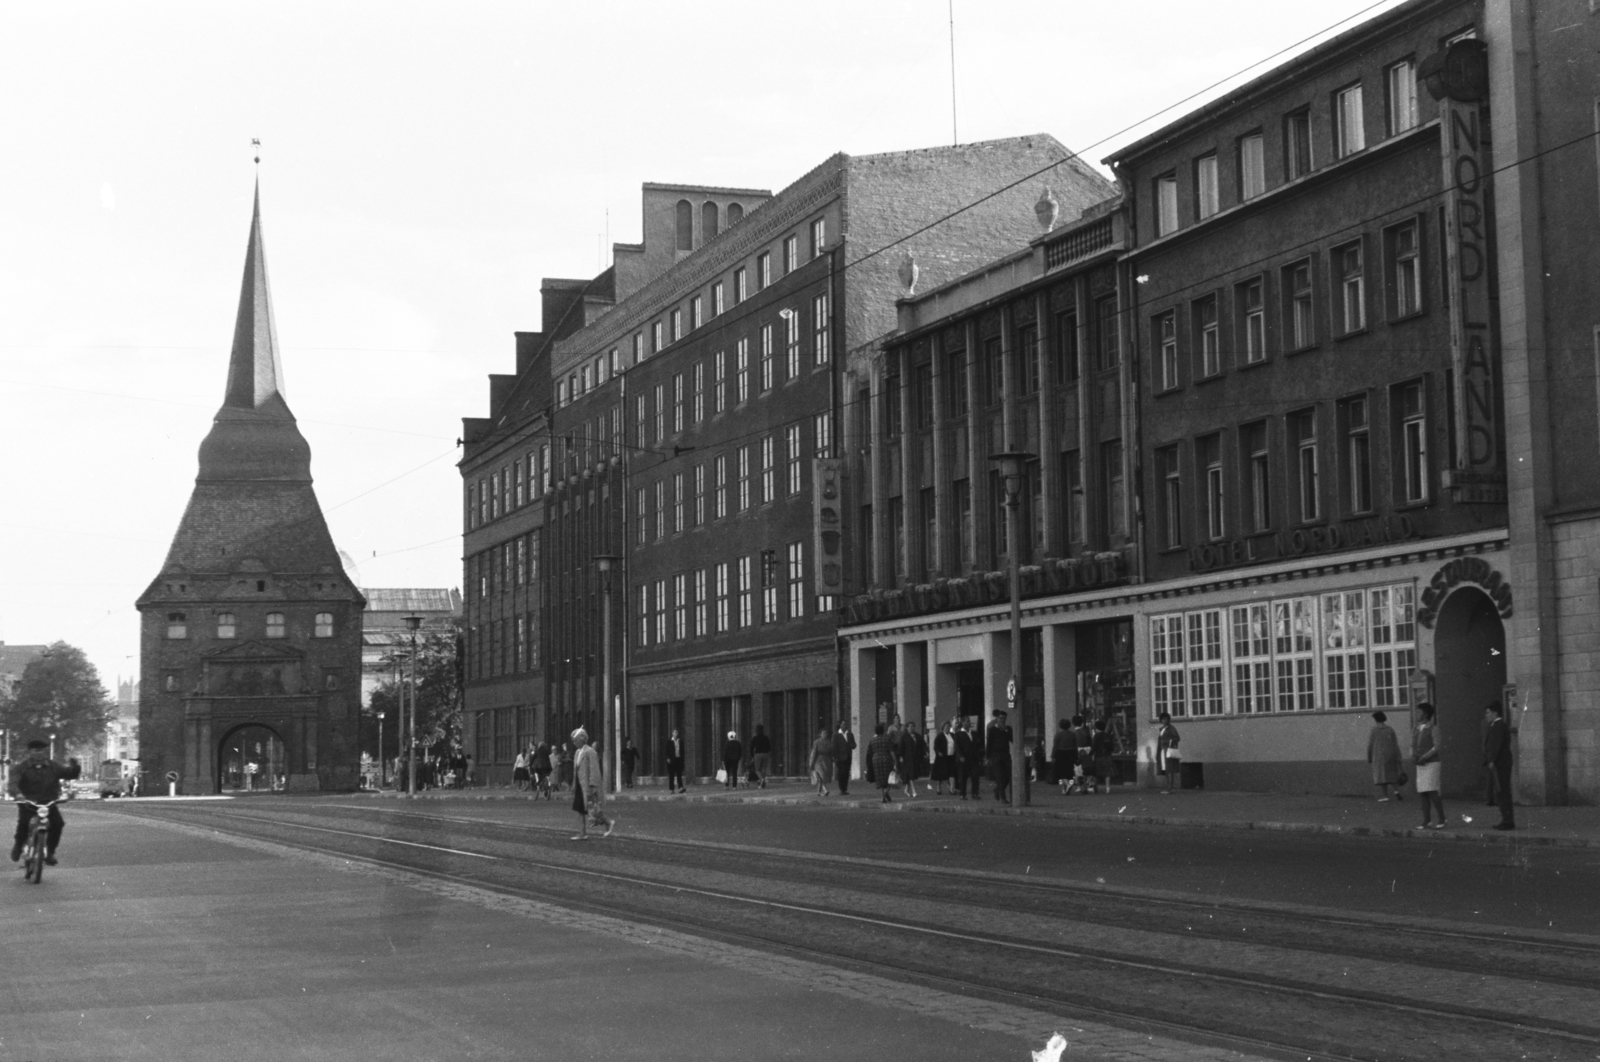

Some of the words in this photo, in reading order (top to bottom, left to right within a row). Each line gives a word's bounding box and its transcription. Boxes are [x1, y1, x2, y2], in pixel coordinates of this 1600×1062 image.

[1452, 109, 1493, 465] NORDLAND
[1189, 538, 1256, 573] HOTEL
[1274, 514, 1413, 556] NORDLAND
